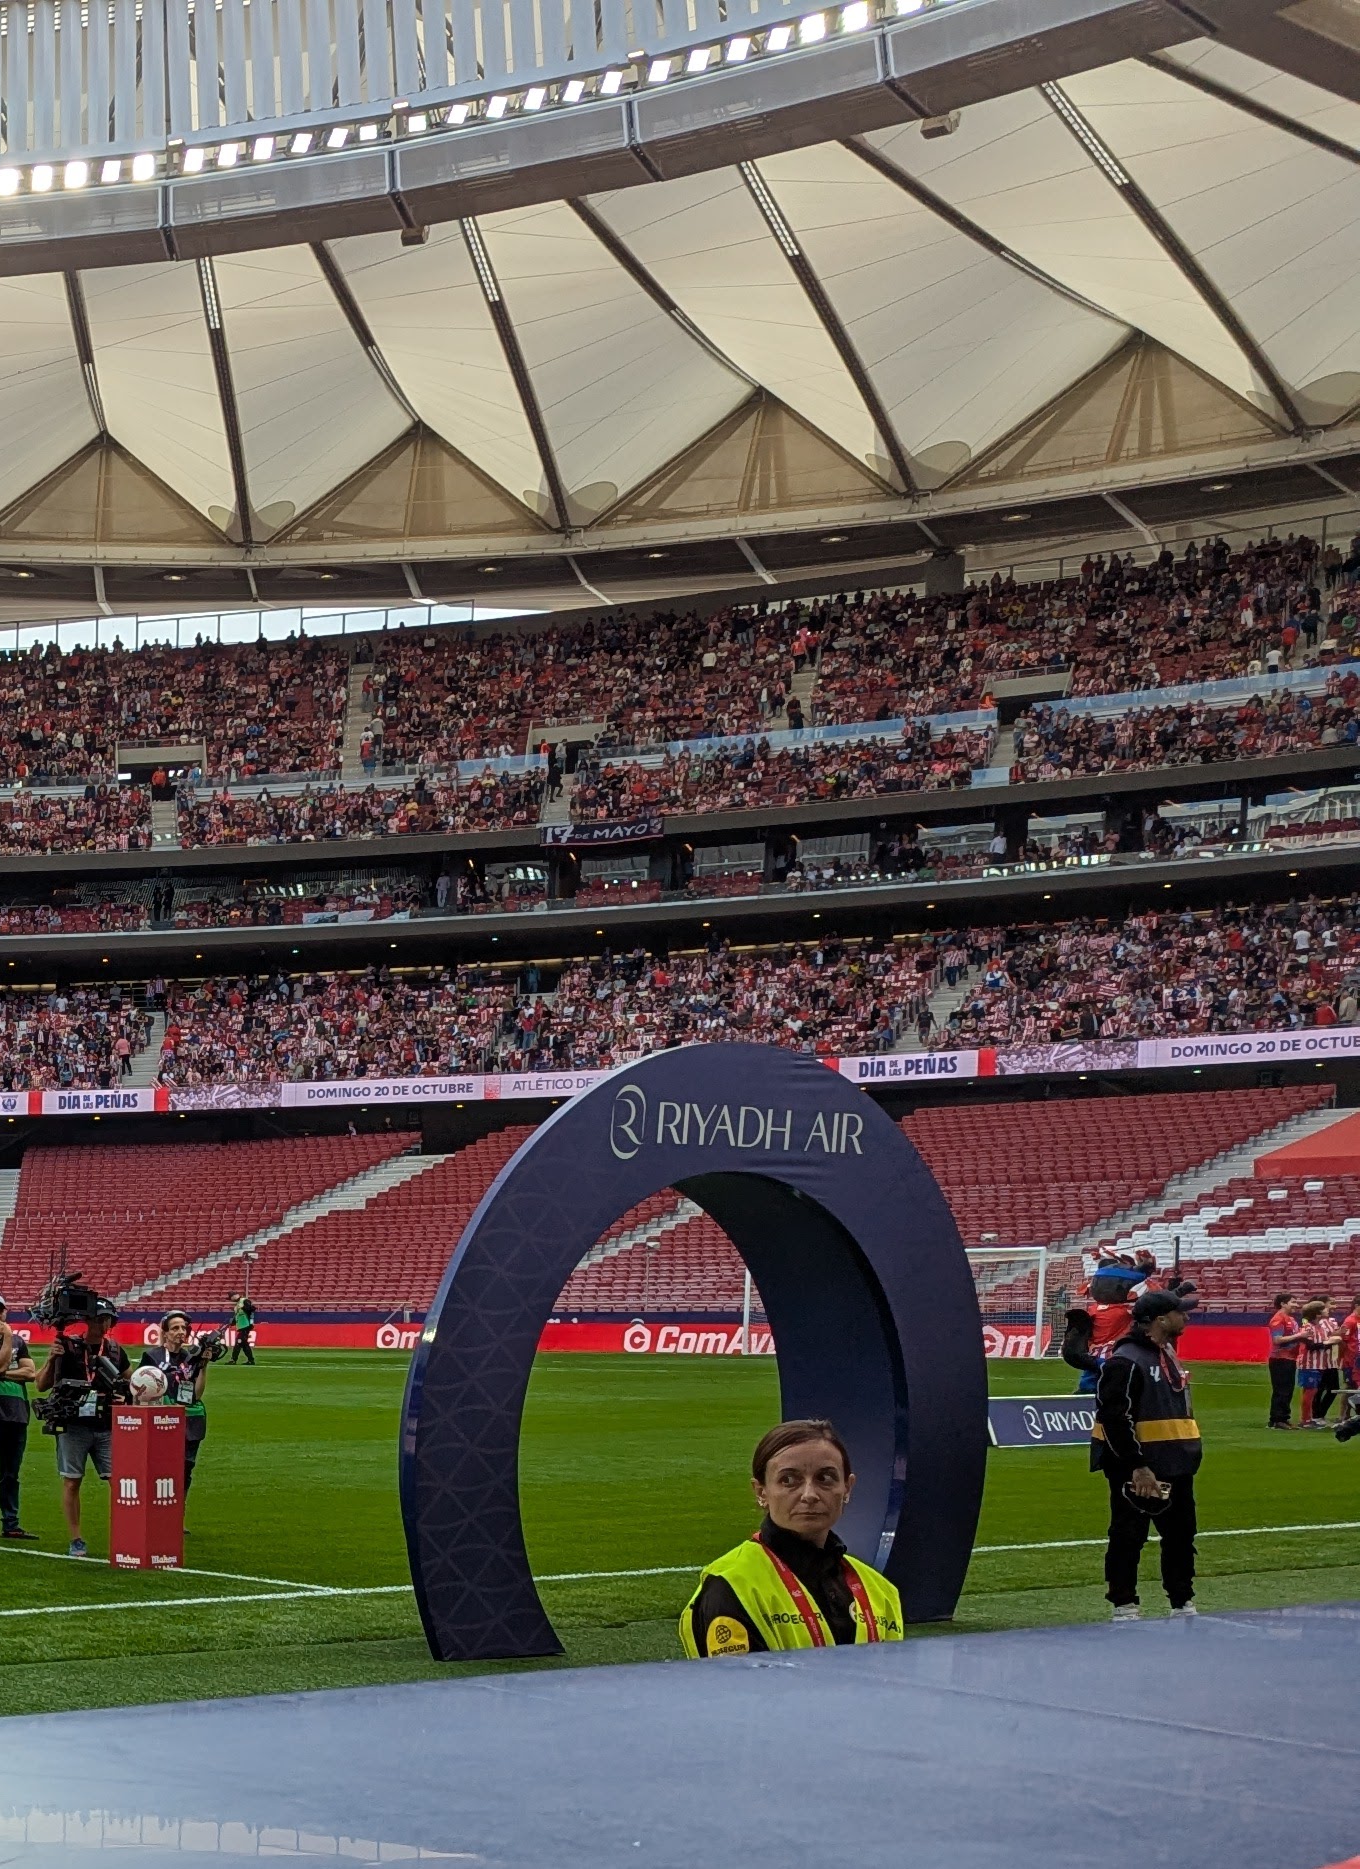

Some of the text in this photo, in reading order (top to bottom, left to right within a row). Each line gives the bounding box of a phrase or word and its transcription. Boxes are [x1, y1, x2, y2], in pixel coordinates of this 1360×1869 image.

[546, 824, 648, 843] 17 DE MAYO
[1171, 1043, 1252, 1059] DOMINGO
[1256, 1041, 1276, 1054] 20
[1280, 1039, 1301, 1052] DE
[858, 1056, 886, 1078] DÍA
[904, 1054, 958, 1075] PEÑAS
[307, 1082, 474, 1099] DOMINGO 20 DE OCTUBRE
[512, 1077, 573, 1091] ATLÉTICO
[58, 1092, 81, 1110] DÍA
[95, 1090, 138, 1109] PEÑAS
[656, 1101, 864, 1155] RIYADH AIR
[1043, 1410, 1098, 1432] RIYAD
